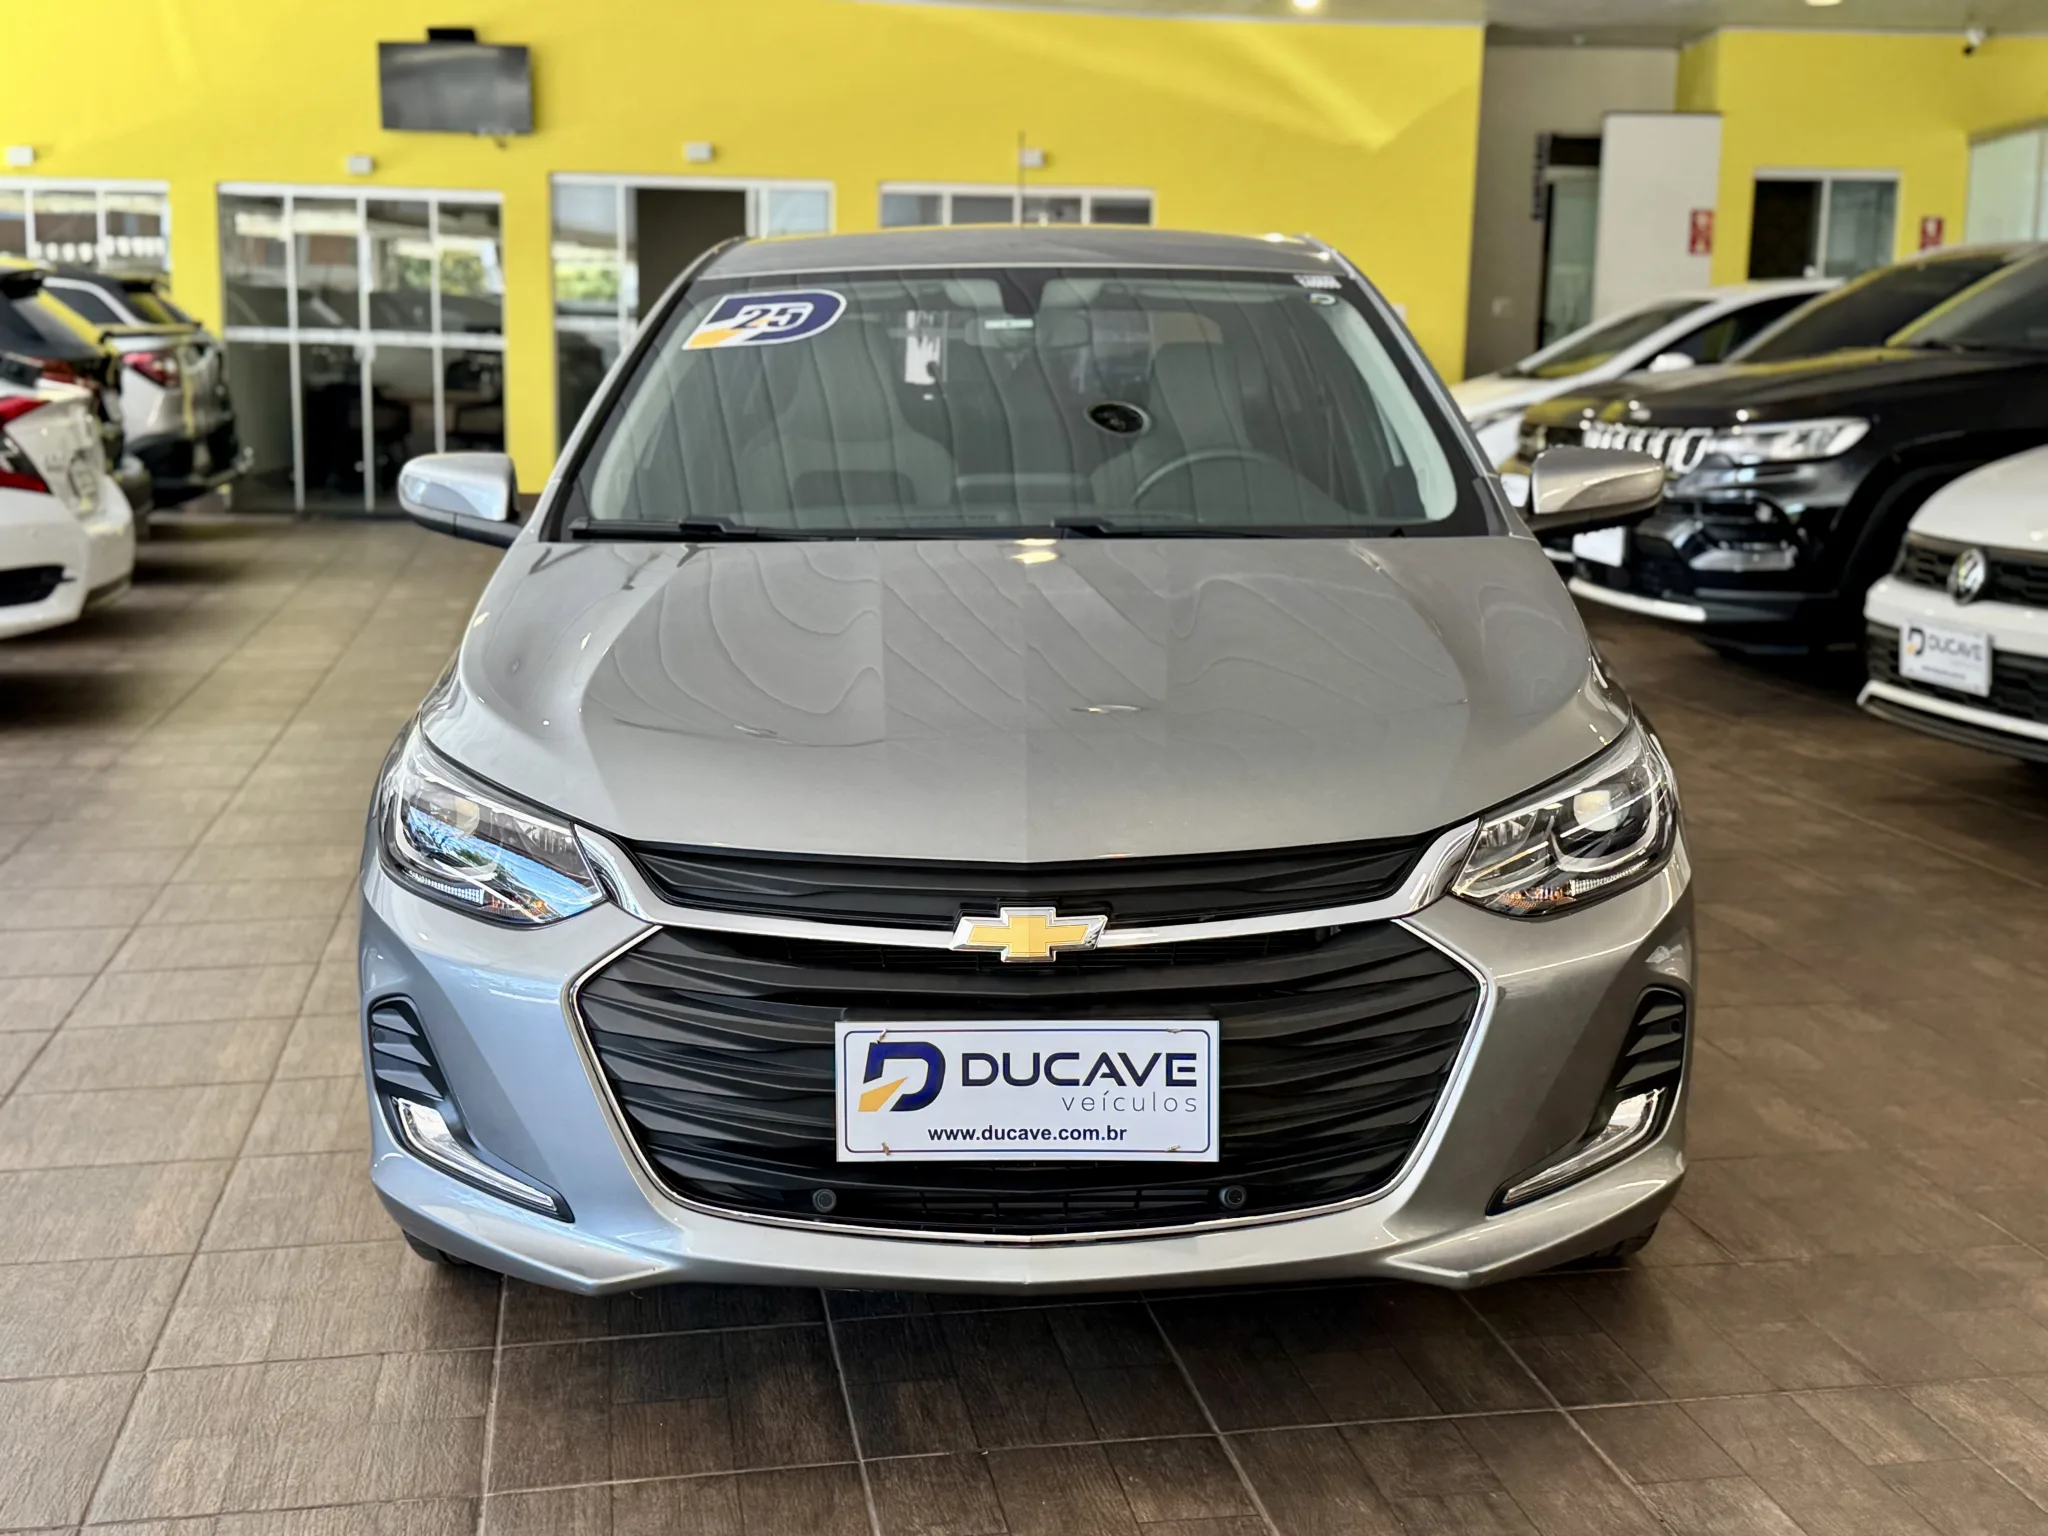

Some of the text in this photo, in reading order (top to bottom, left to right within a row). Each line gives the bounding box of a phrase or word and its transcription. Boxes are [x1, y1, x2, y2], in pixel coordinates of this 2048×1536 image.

[961, 1052, 1197, 1087] DUCAVE
[1062, 1090, 1197, 1113] veículos
[928, 1125, 1127, 1141] www.ducave.com.br
